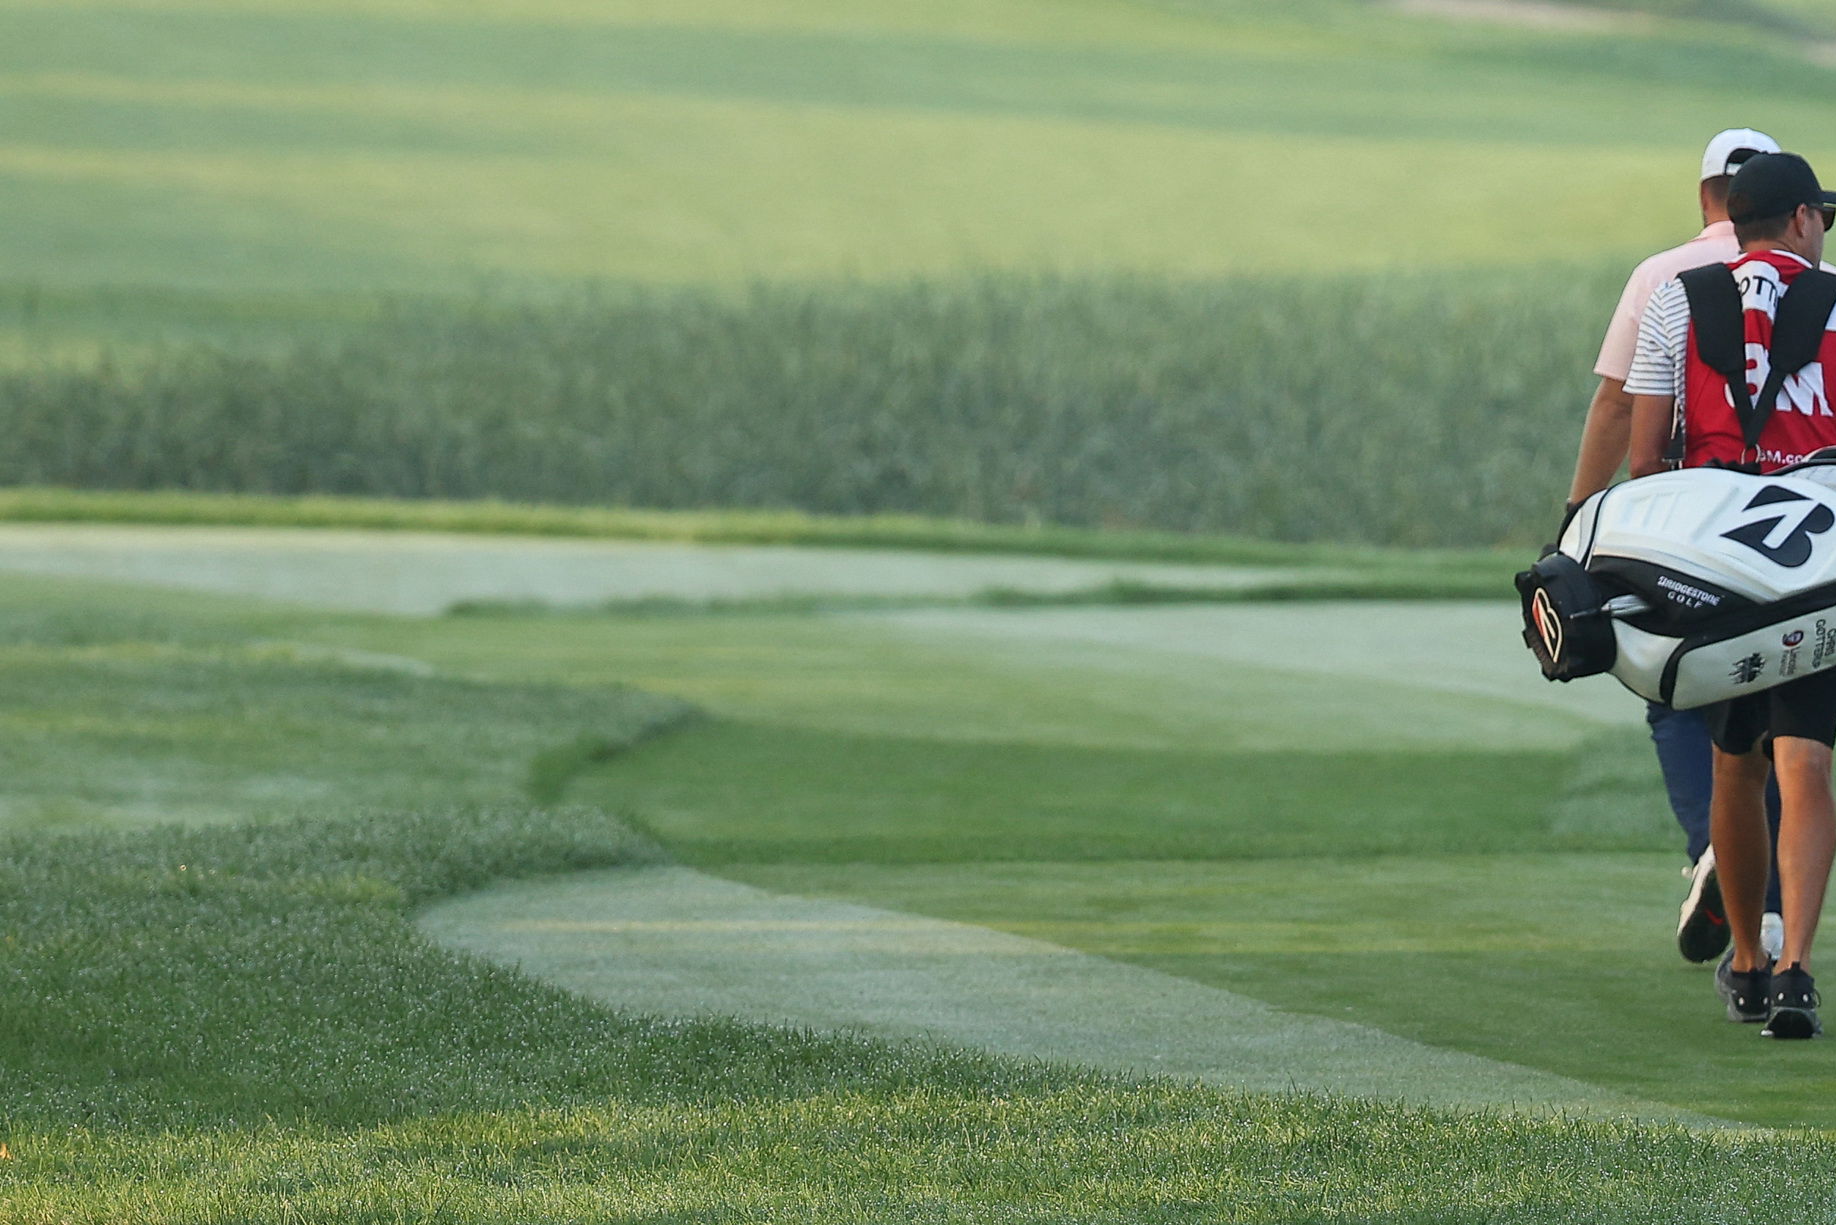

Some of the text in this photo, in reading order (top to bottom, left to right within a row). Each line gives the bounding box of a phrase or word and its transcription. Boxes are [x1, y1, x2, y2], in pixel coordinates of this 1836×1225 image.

[1758, 448, 1804, 464] 3M.co
[1657, 575, 1721, 607] BRIDGESTONE
[1667, 590, 1704, 609] GOLF
